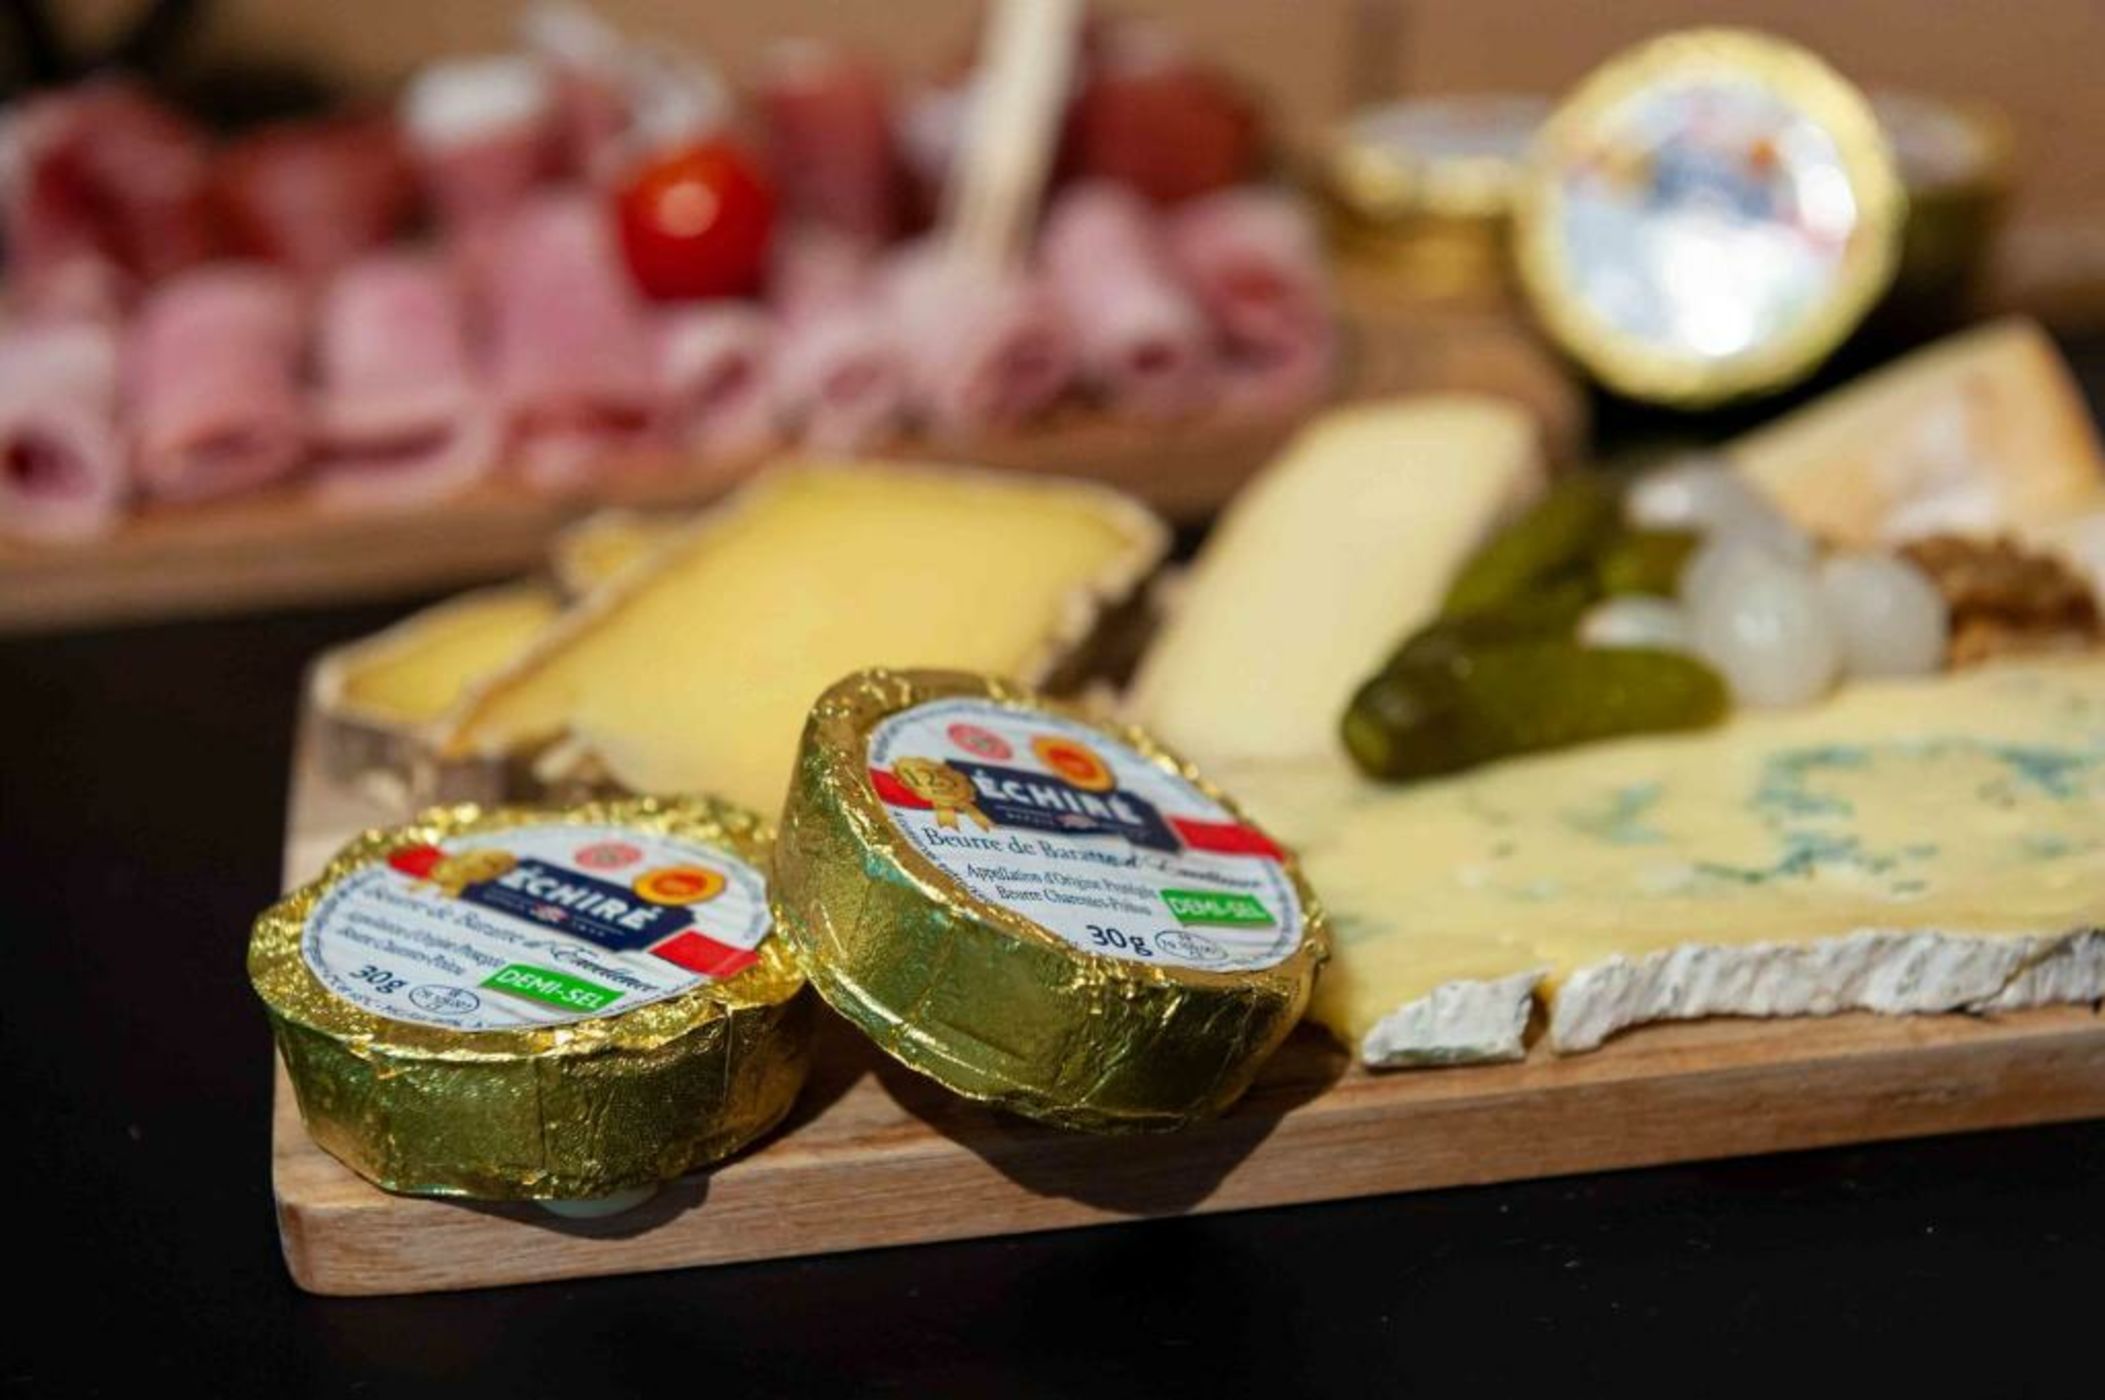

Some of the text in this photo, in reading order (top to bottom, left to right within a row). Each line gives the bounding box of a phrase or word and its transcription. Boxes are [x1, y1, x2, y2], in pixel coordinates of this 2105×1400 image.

[970, 768, 1144, 825] ÉCHIRÉ
[923, 826, 1002, 852] Beurre
[1008, 836, 1037, 856] de
[500, 864, 664, 931] ÉCHIRÉ
[497, 970, 604, 1008] DEMI-SEL
